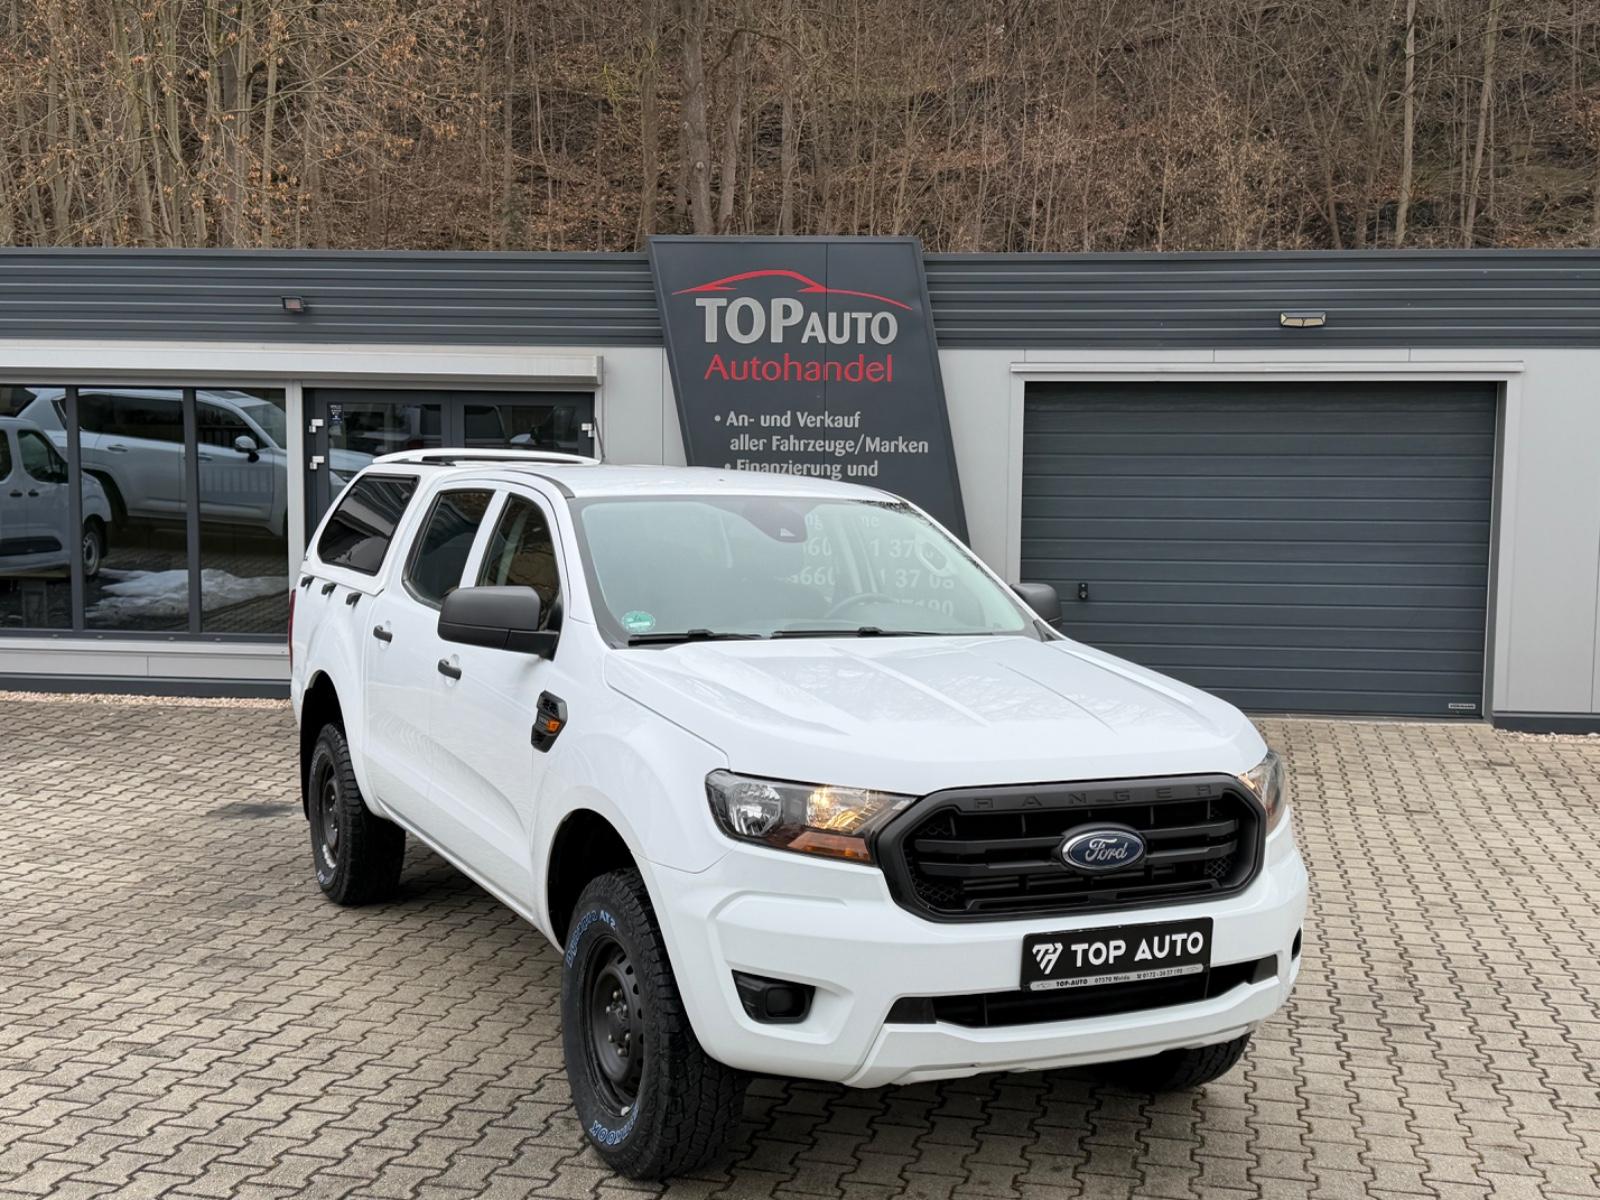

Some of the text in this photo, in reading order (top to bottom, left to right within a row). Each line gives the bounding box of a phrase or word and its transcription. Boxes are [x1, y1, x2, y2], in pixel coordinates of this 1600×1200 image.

[704, 352, 893, 383] Autohandel
[726, 410, 861, 428] An- und Verkauf
[730, 433, 929, 456] aller Fahrzeuge/Marken
[736, 459, 879, 480] Finanzierung und
[973, 784, 1213, 809] RANGER
[1085, 838, 1128, 862] Ford
[1070, 931, 1204, 968] TOP AUTO
